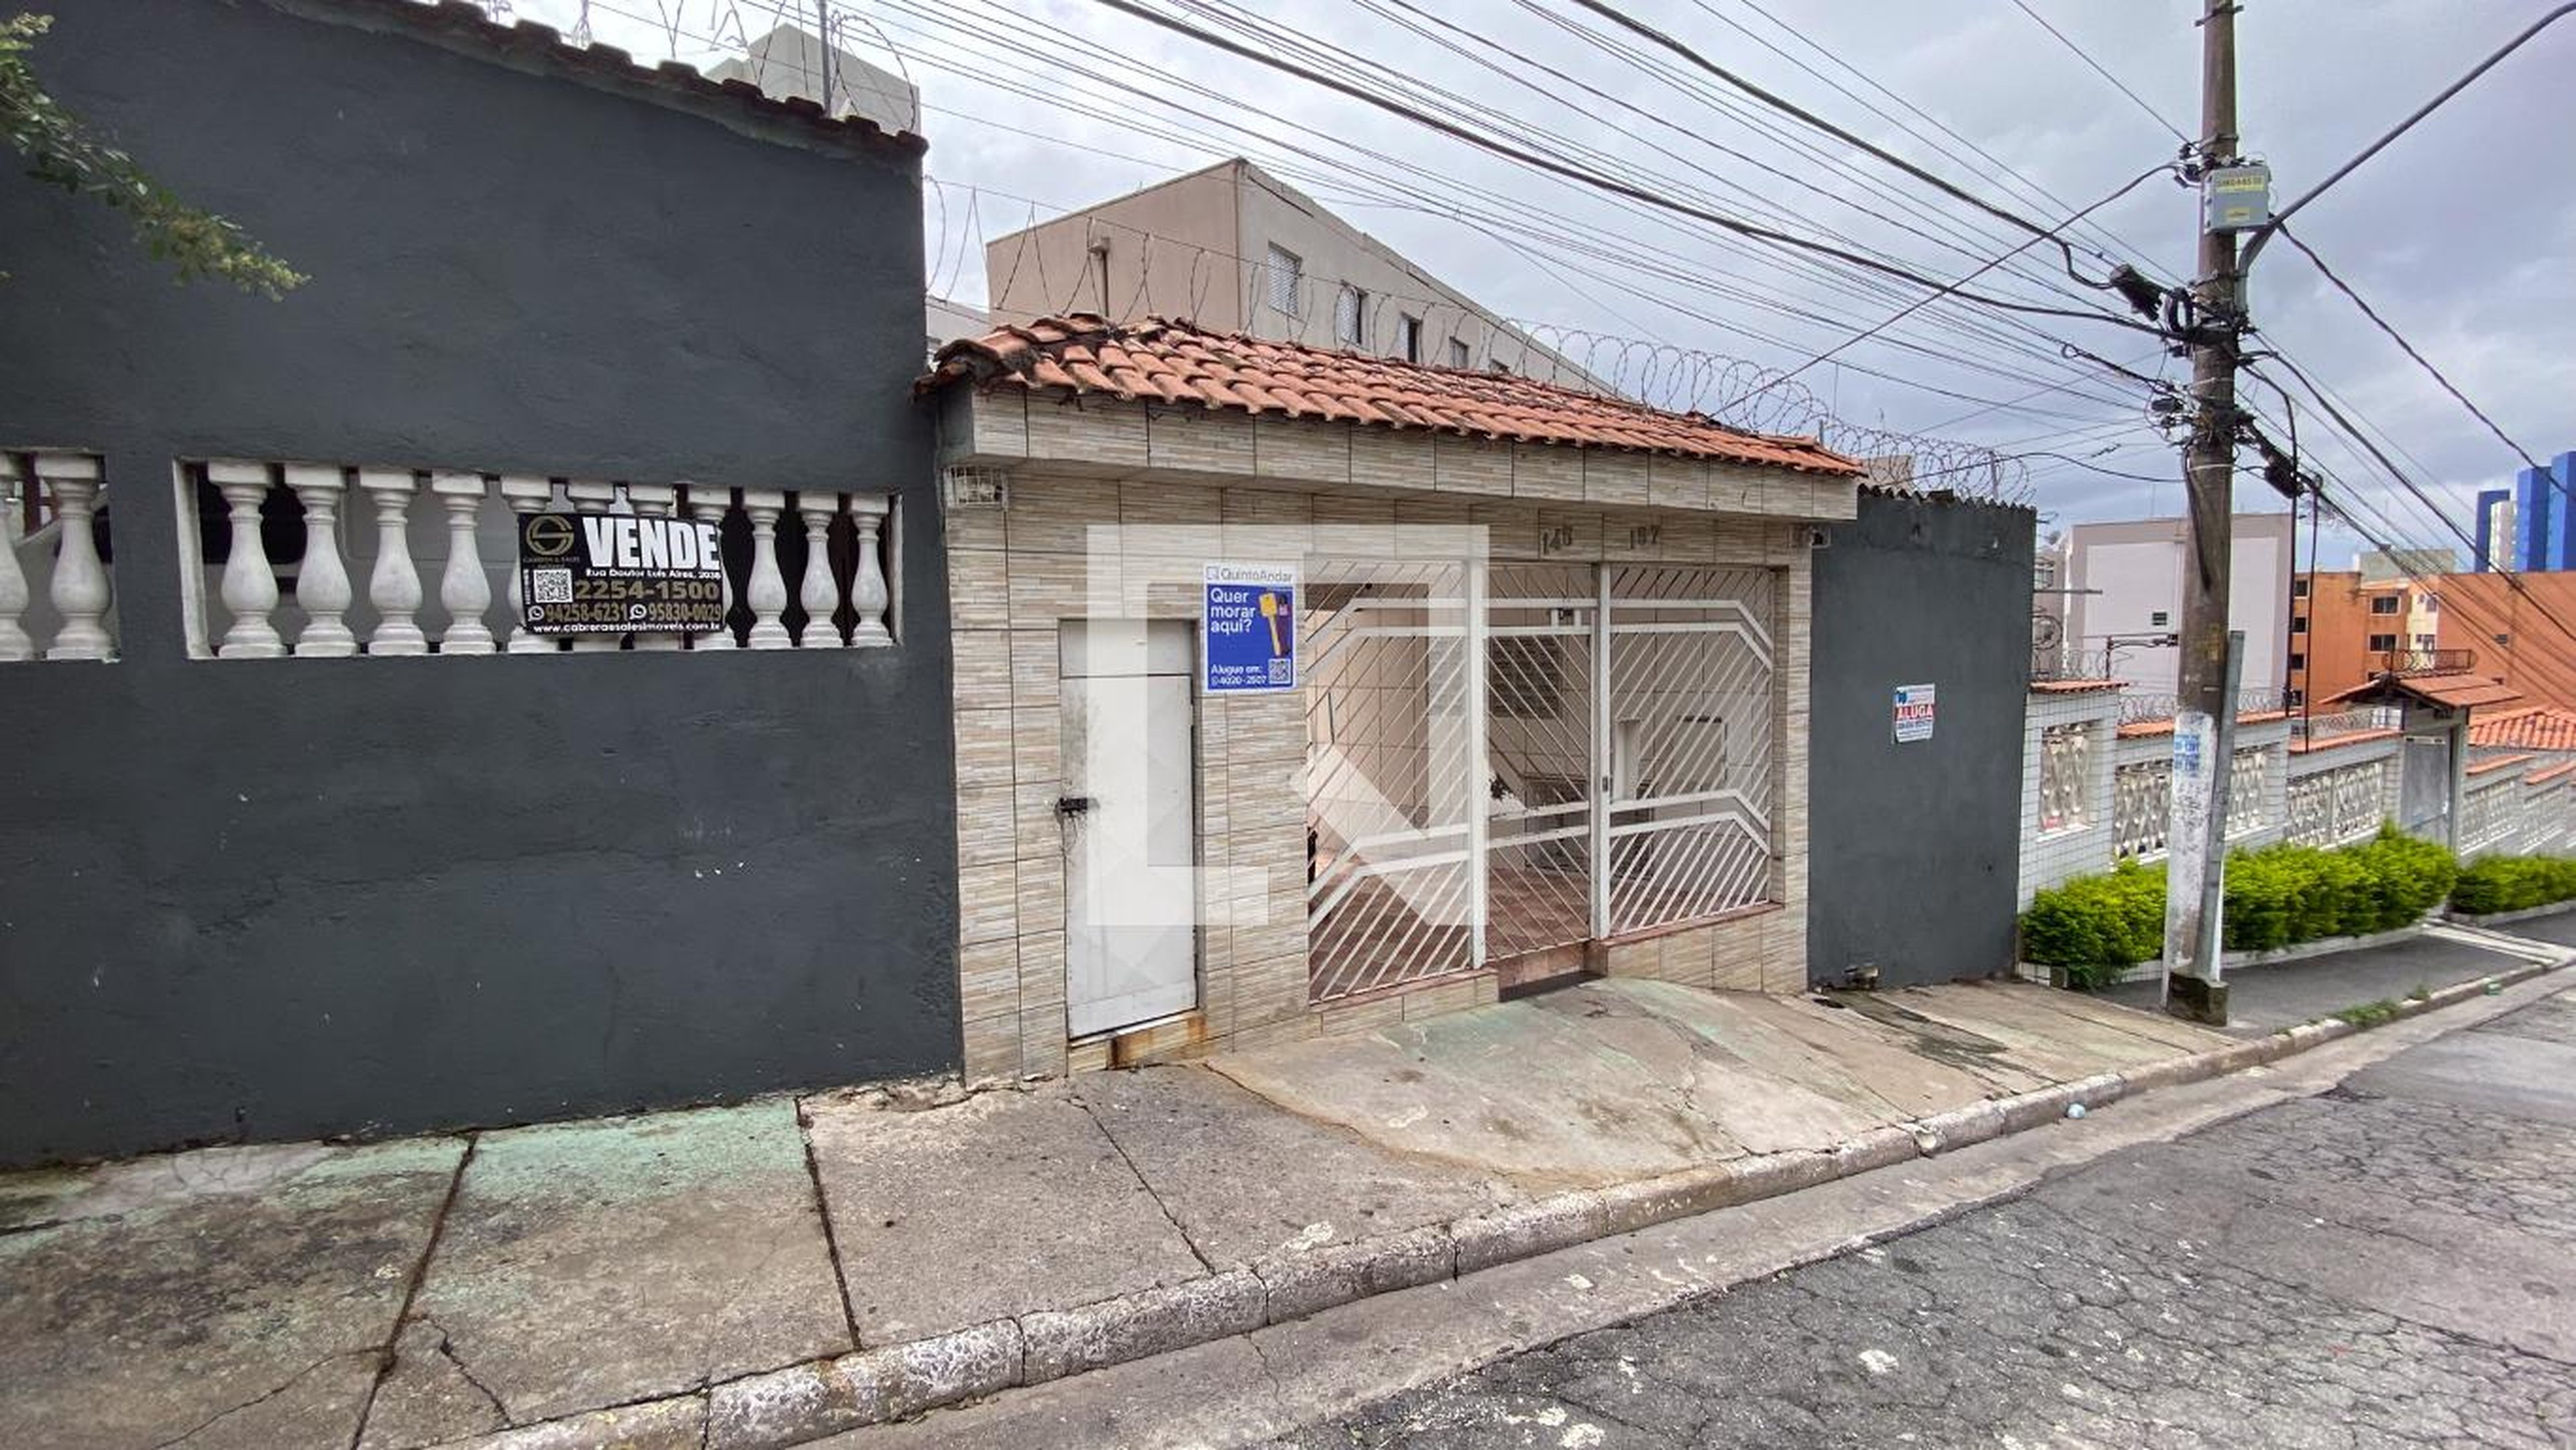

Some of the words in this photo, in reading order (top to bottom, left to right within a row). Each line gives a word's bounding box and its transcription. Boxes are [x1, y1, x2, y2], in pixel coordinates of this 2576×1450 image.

[583, 517, 720, 570] VENDE
[1220, 567, 1292, 582] QuintoAndar
[575, 580, 719, 599] 2254-1500
[1210, 588, 1250, 603] Quer
[545, 603, 628, 622] 94258-6231
[1210, 605, 1255, 618] morar
[1210, 619, 1252, 635] aqui?
[1211, 664, 1244, 676] Alugue
[1896, 703, 1933, 721] ALUGA
